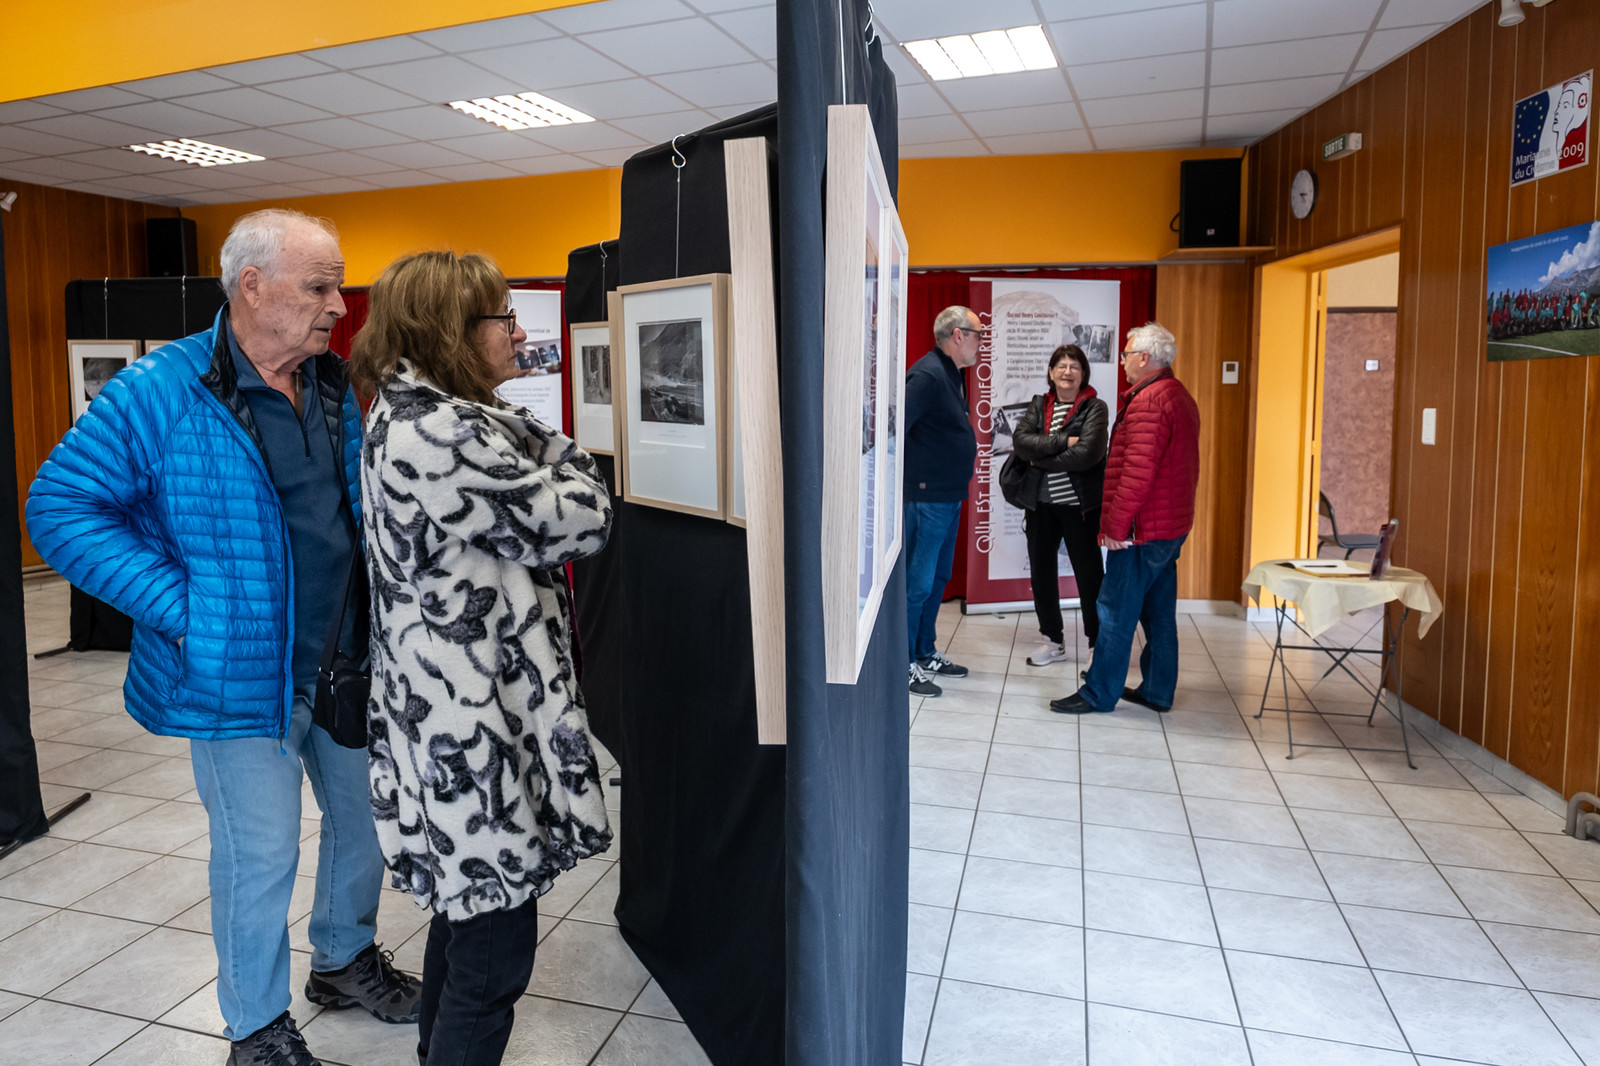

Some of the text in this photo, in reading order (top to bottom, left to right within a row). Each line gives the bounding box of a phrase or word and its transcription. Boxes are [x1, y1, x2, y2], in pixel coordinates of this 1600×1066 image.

[1515, 147, 1551, 167] Marianne
[1557, 141, 1585, 160] 2009
[1514, 160, 1556, 180] du Civisme
[975, 442, 995, 484] HENRY
[975, 491, 995, 513] EST
[975, 521, 995, 554] QUI
